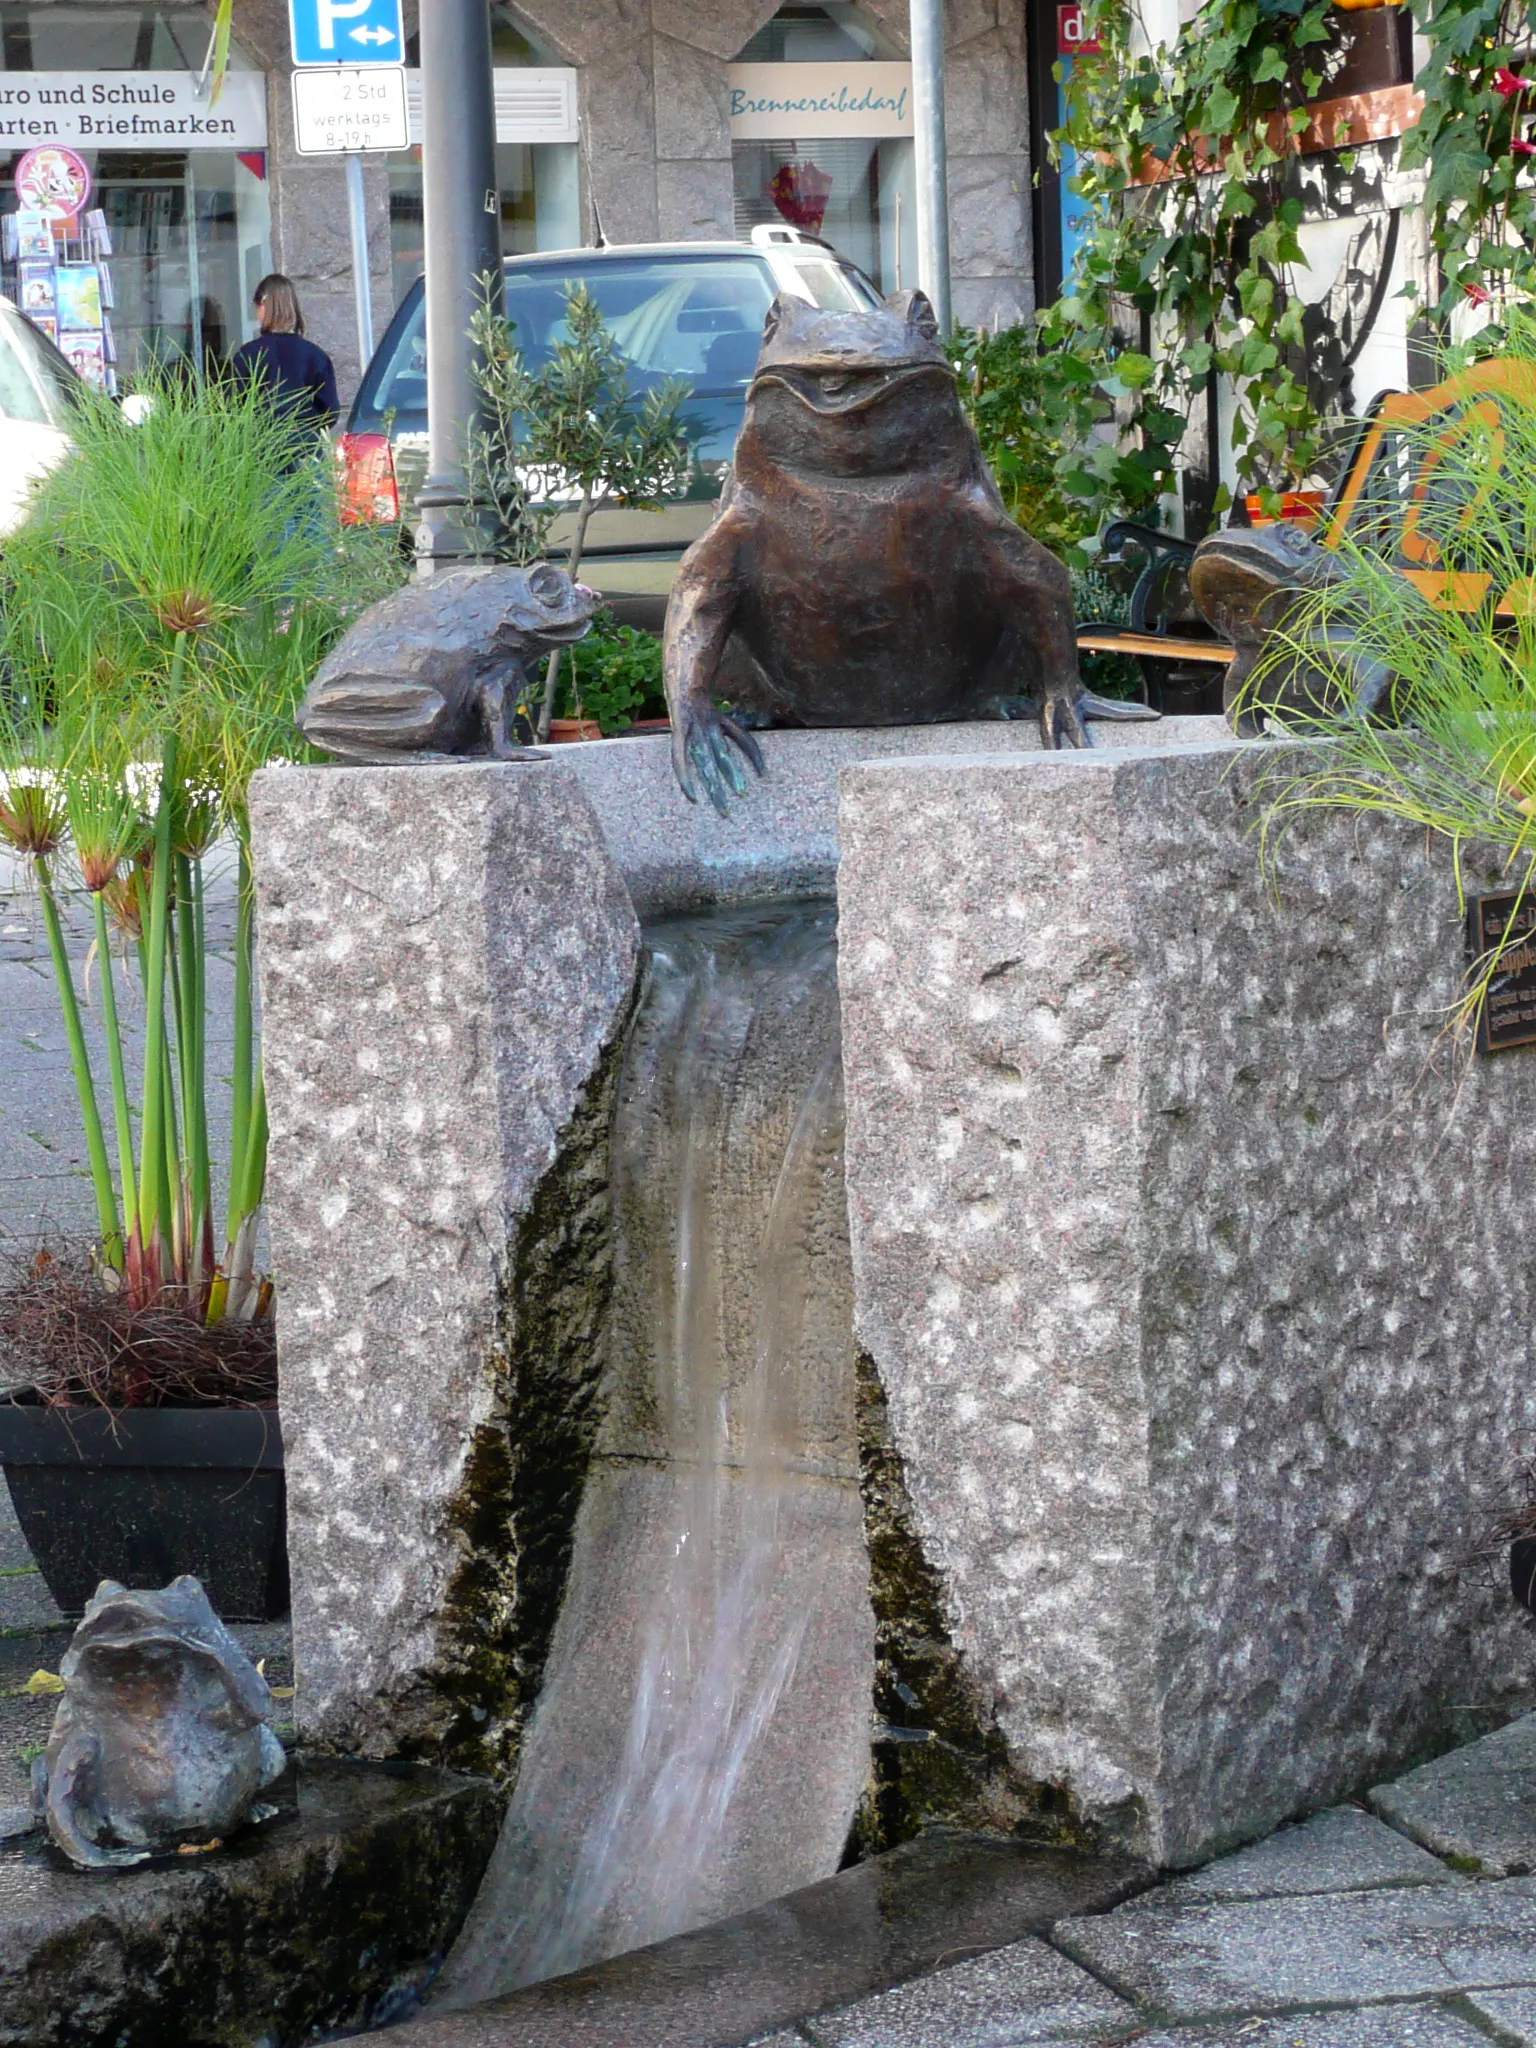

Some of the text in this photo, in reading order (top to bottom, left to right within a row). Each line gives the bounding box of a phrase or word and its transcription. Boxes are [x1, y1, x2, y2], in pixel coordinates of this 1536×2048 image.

[317, 0, 373, 49] P
[0, 84, 175, 104] ro und Schule
[343, 84, 386, 100] 2 Std
[730, 86, 907, 120] Brennereibedarf
[78, 114, 236, 134] Briefmarken
[313, 112, 391, 128] werktags
